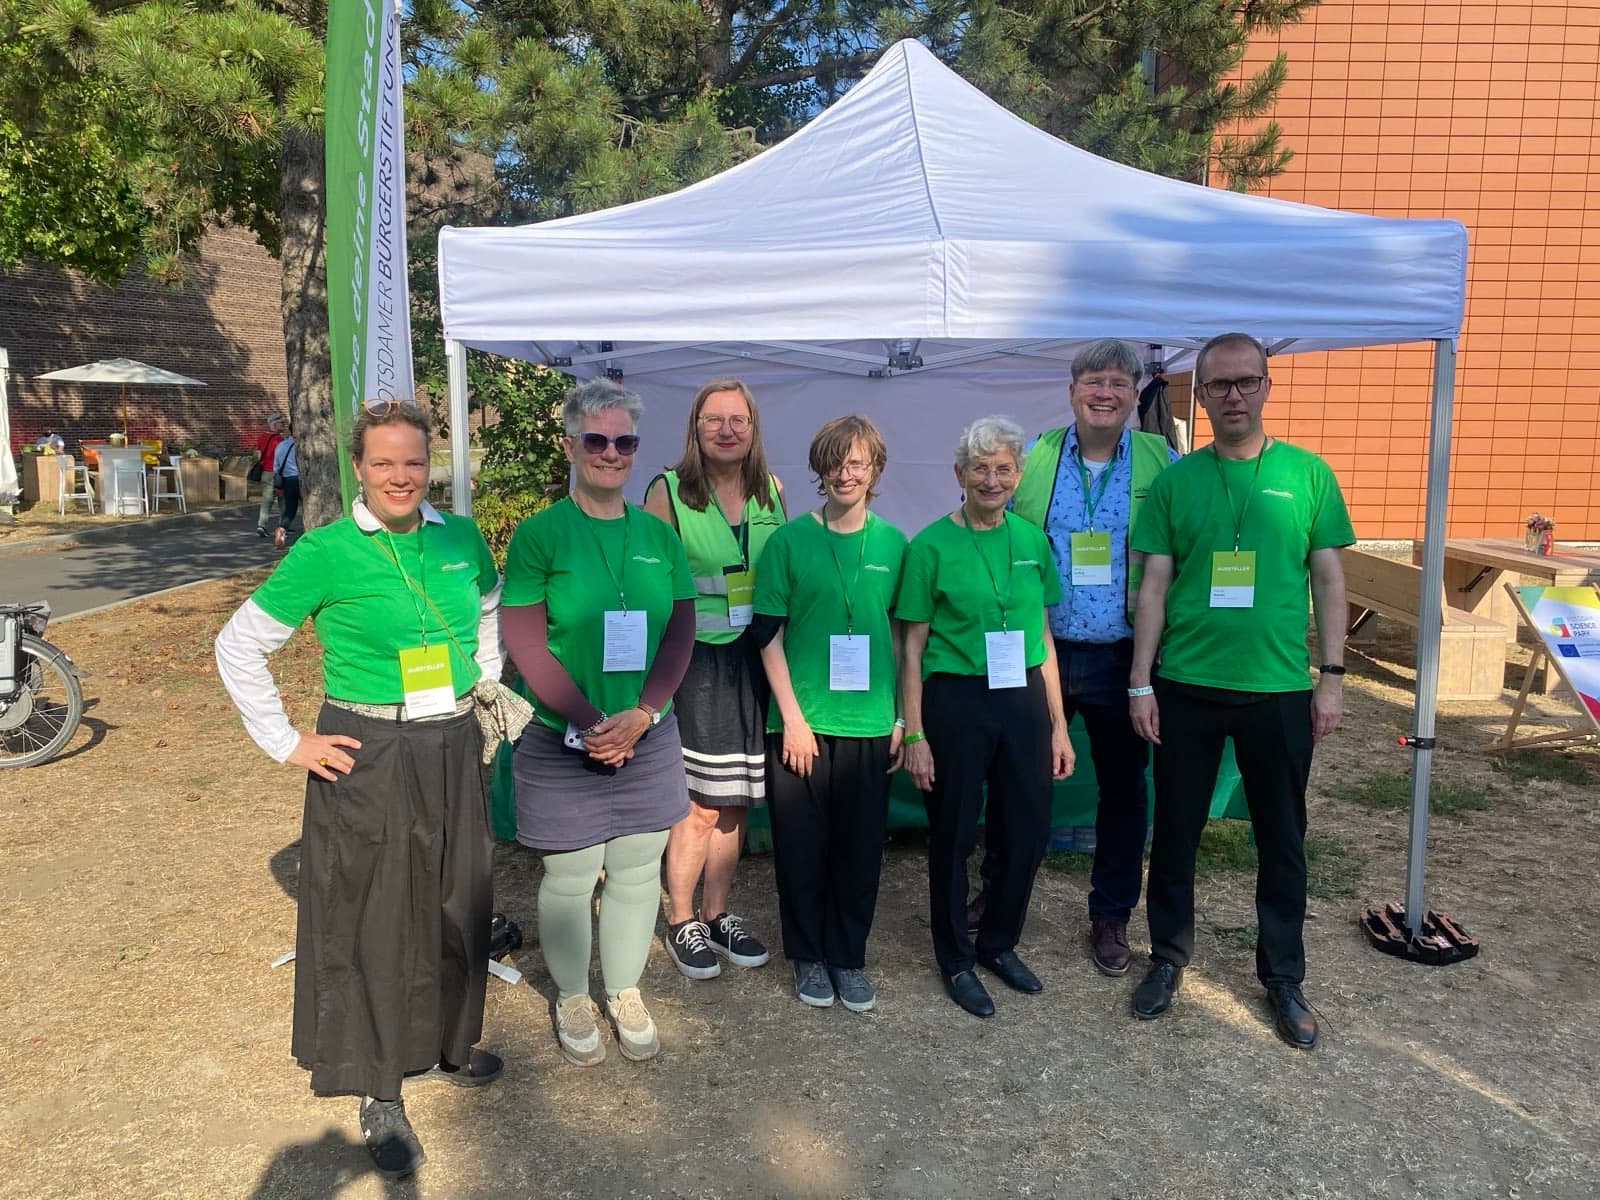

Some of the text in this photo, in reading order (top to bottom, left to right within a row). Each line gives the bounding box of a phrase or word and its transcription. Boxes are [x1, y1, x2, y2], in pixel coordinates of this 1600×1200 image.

[351, 171, 366, 324] deine
[376, 14, 395, 401] OTSDAMER BÜRGERSTIFTUNG
[350, 334, 360, 424] ebe
